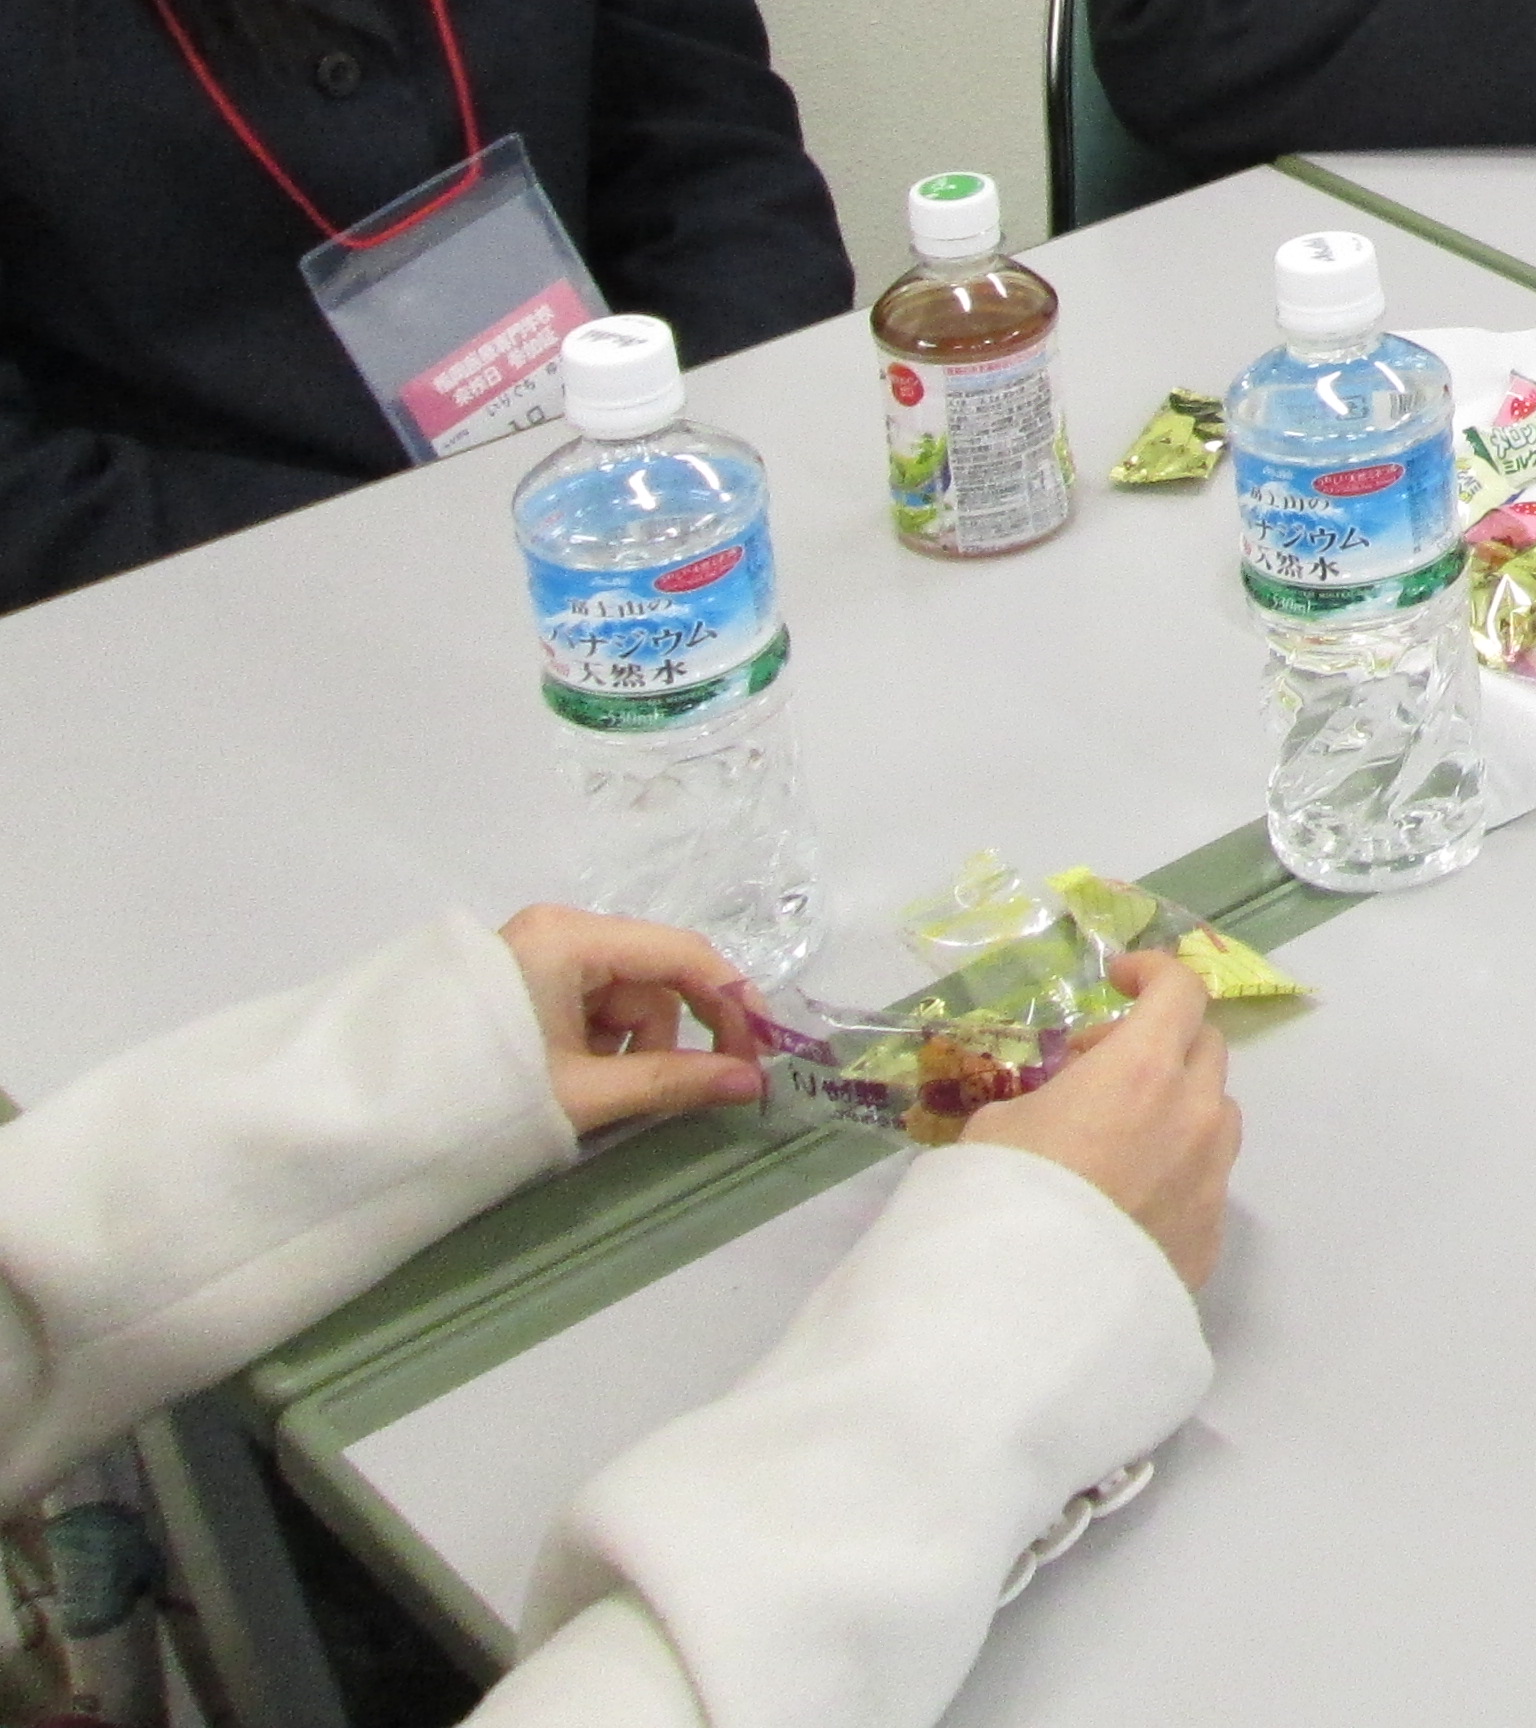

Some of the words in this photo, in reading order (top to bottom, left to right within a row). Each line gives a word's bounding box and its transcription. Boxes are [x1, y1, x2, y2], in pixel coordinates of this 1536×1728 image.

[1255, 545, 1340, 582] 天然水
[567, 597, 673, 618] 富士山の
[550, 620, 718, 660] バナジウム
[576, 658, 688, 688] 天然水
